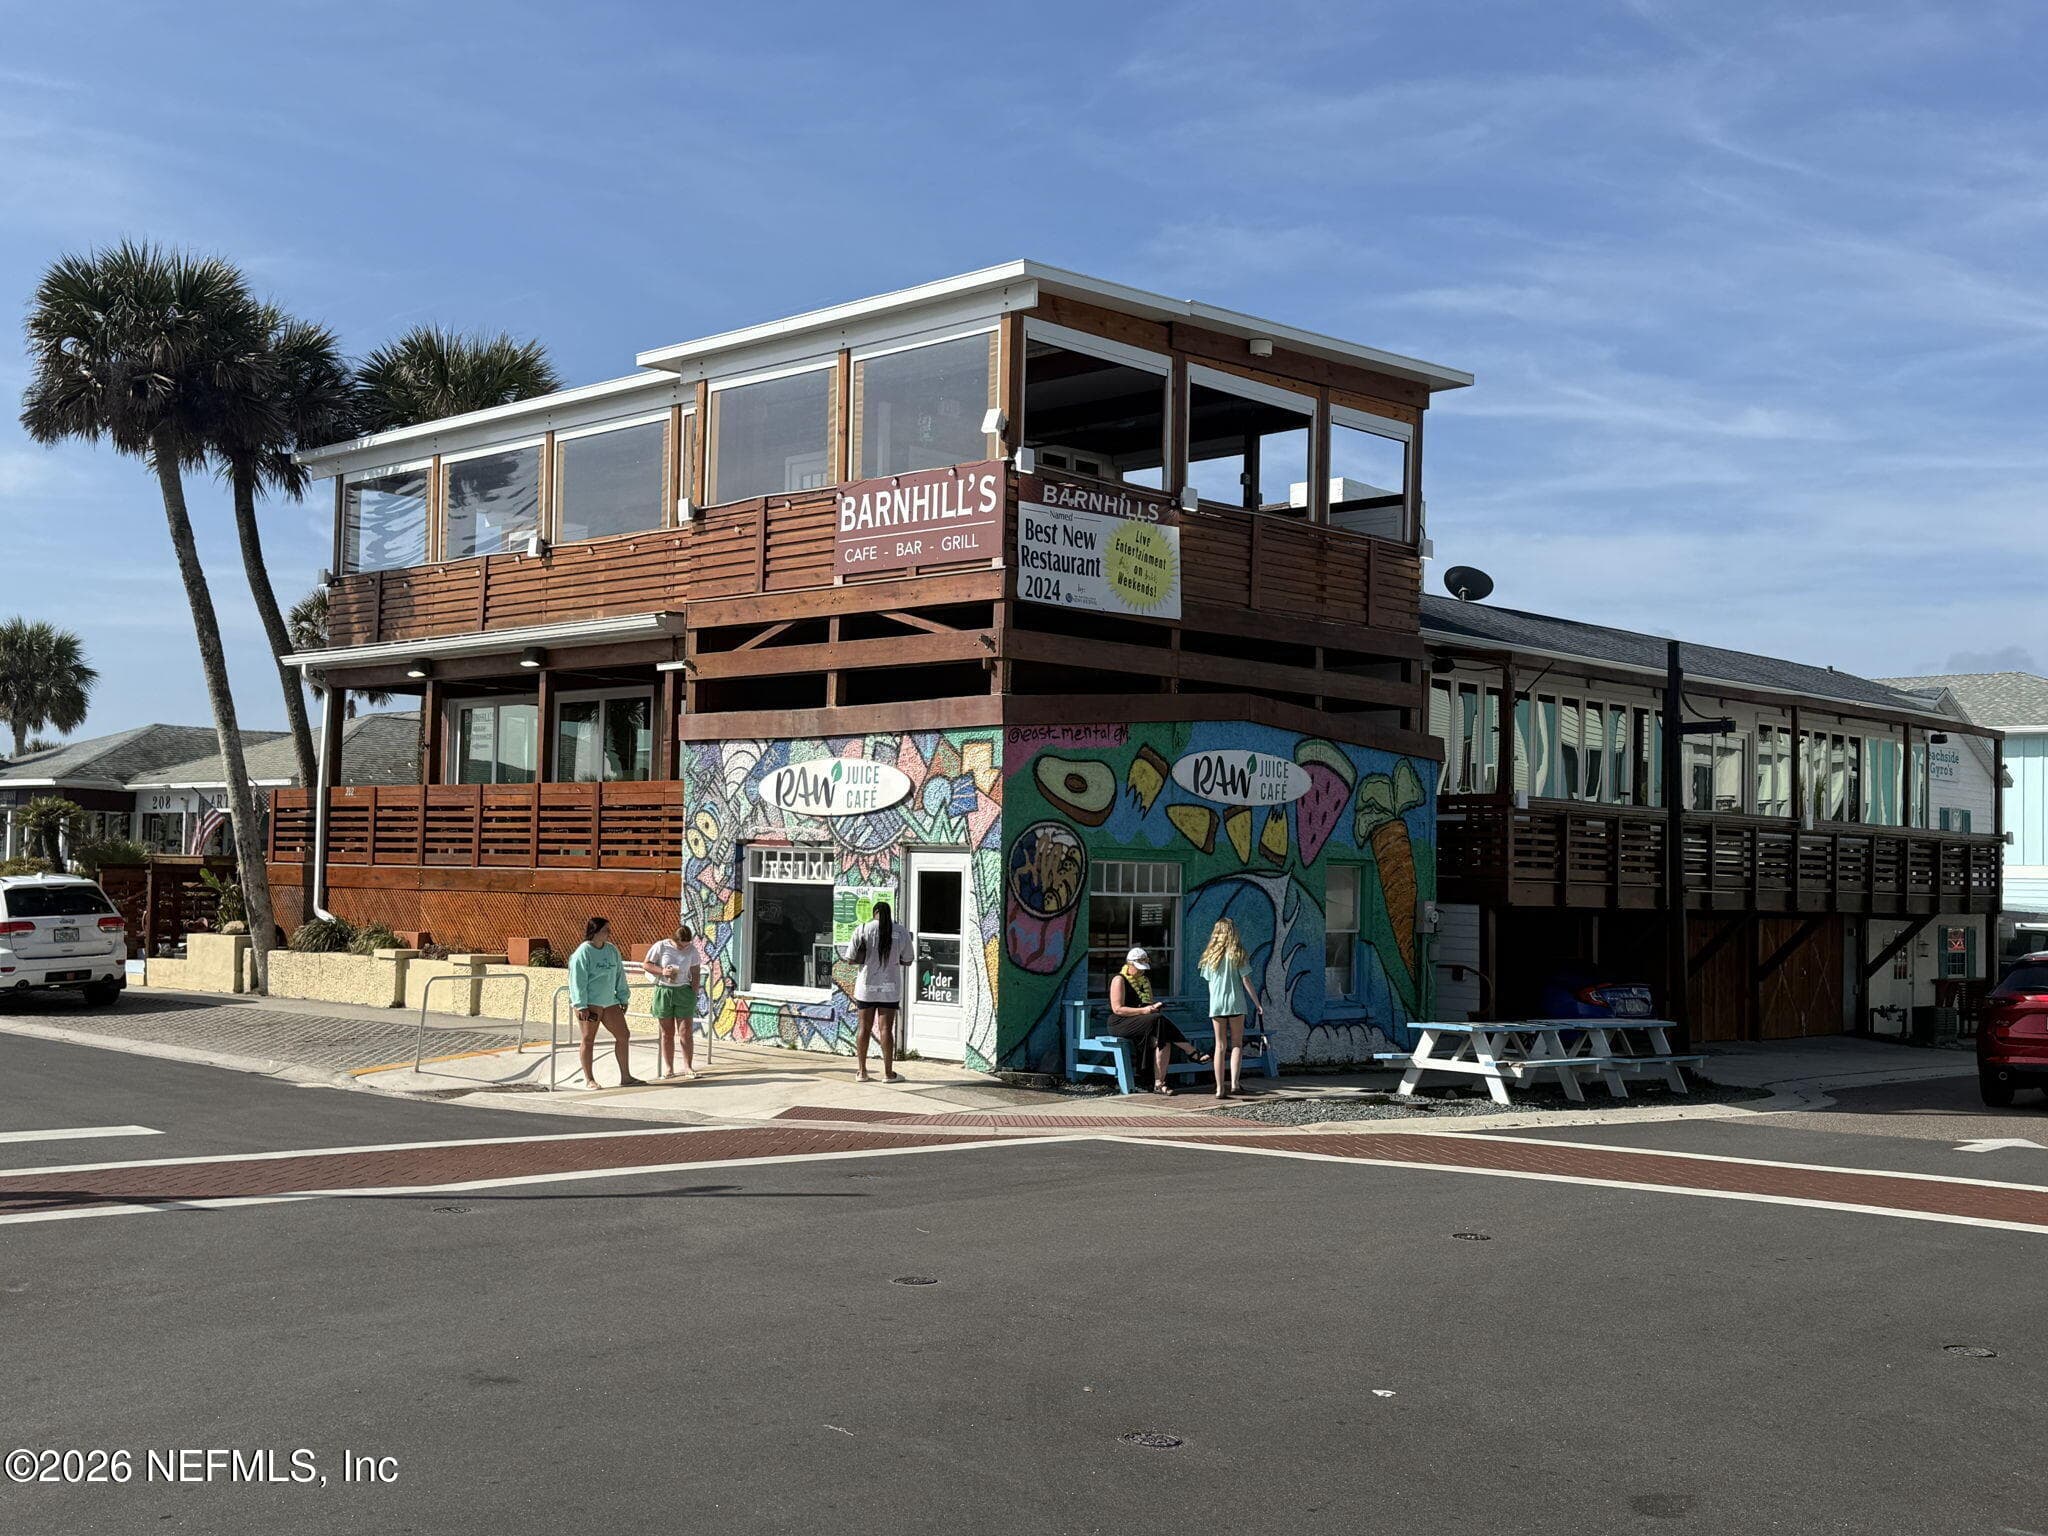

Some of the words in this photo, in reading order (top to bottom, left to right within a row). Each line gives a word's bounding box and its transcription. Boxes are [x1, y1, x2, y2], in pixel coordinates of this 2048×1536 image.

[840, 473, 997, 533] BARNHILL'S
[1043, 484, 1159, 521] BARNHILLS
[1049, 510, 1074, 521] Named
[1025, 518, 1058, 545] Best
[1062, 524, 1097, 550] New
[1135, 530, 1151, 547] Live
[844, 545, 878, 562] CAFE
[896, 540, 922, 557] BAR
[941, 533, 979, 551] GRILL
[1115, 538, 1166, 570] Entertainment
[1021, 544, 1101, 578] Restaurant
[1133, 565, 1143, 577] on
[1025, 575, 1061, 601] 2024
[1117, 571, 1157, 598] Weekends!
[1193, 755, 1251, 799] RAW
[1259, 759, 1289, 779] JUICE
[1930, 762, 1953, 777] Gyro's
[775, 766, 836, 809] RAW
[846, 765, 880, 784] JUICE
[846, 786, 877, 809] CAFÉ
[1260, 780, 1287, 801] CAFÉ
[152, 795, 171, 809] 208
[928, 985, 952, 1002] Here
